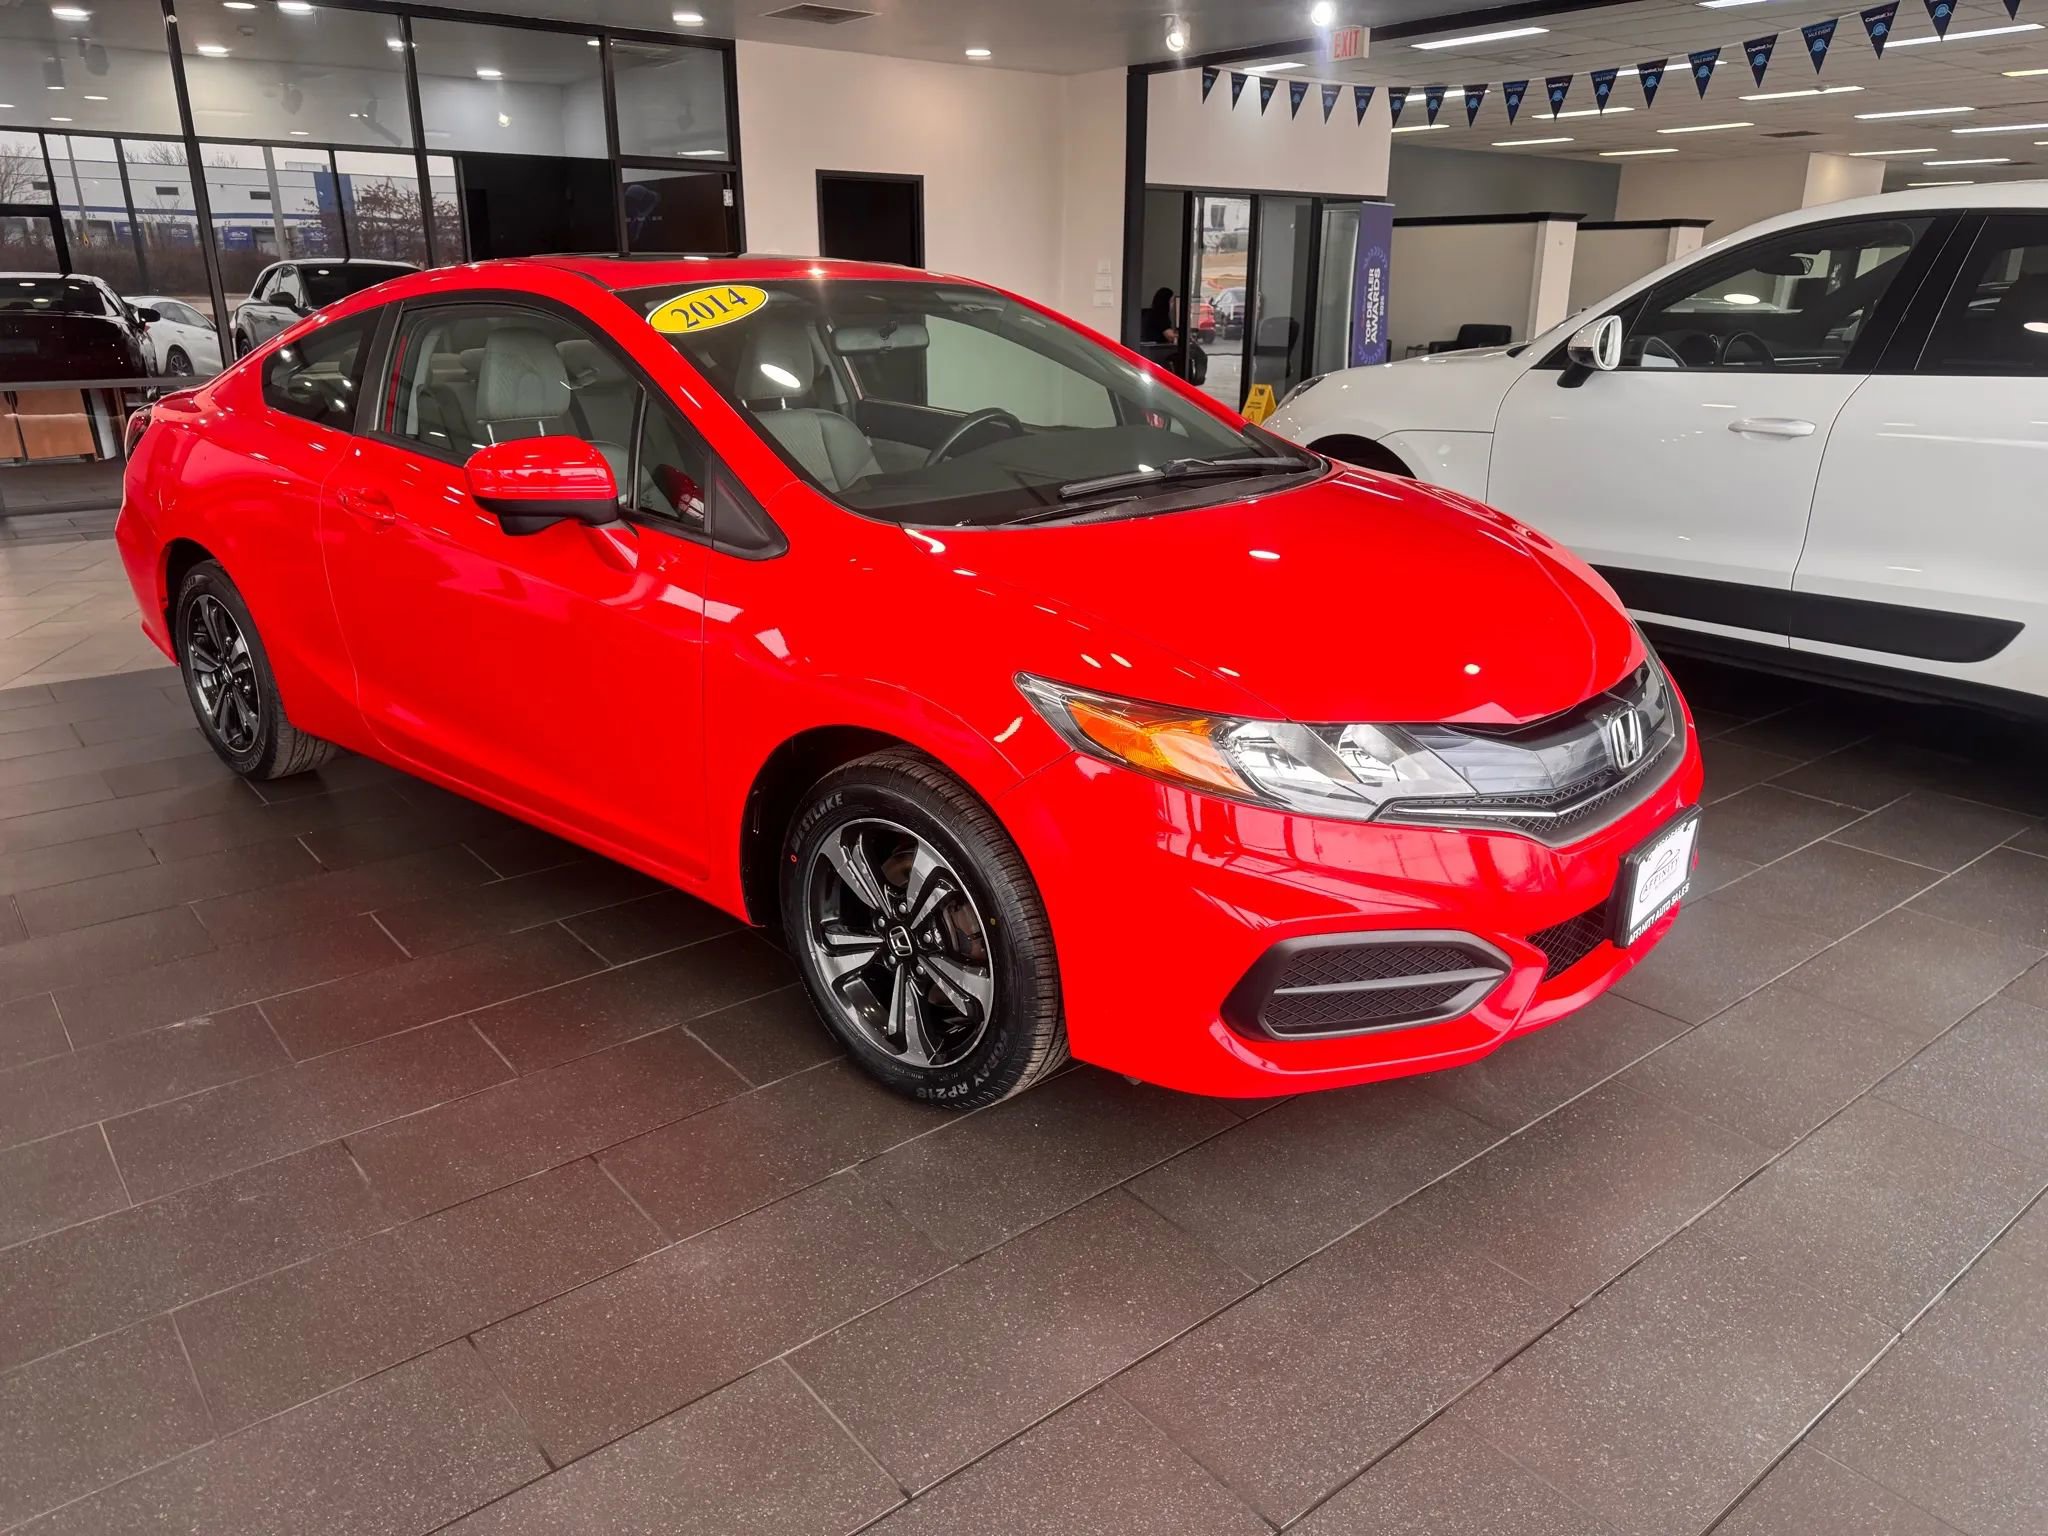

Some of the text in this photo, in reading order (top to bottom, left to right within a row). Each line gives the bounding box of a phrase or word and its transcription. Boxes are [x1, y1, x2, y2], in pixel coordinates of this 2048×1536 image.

[1333, 29, 1361, 59] EXIT
[670, 288, 748, 329] 2014
[1366, 268, 1375, 319] DEALER
[1370, 267, 1381, 344] AWARDS
[1628, 882, 1690, 946] AFFINITY AUTO SALES
